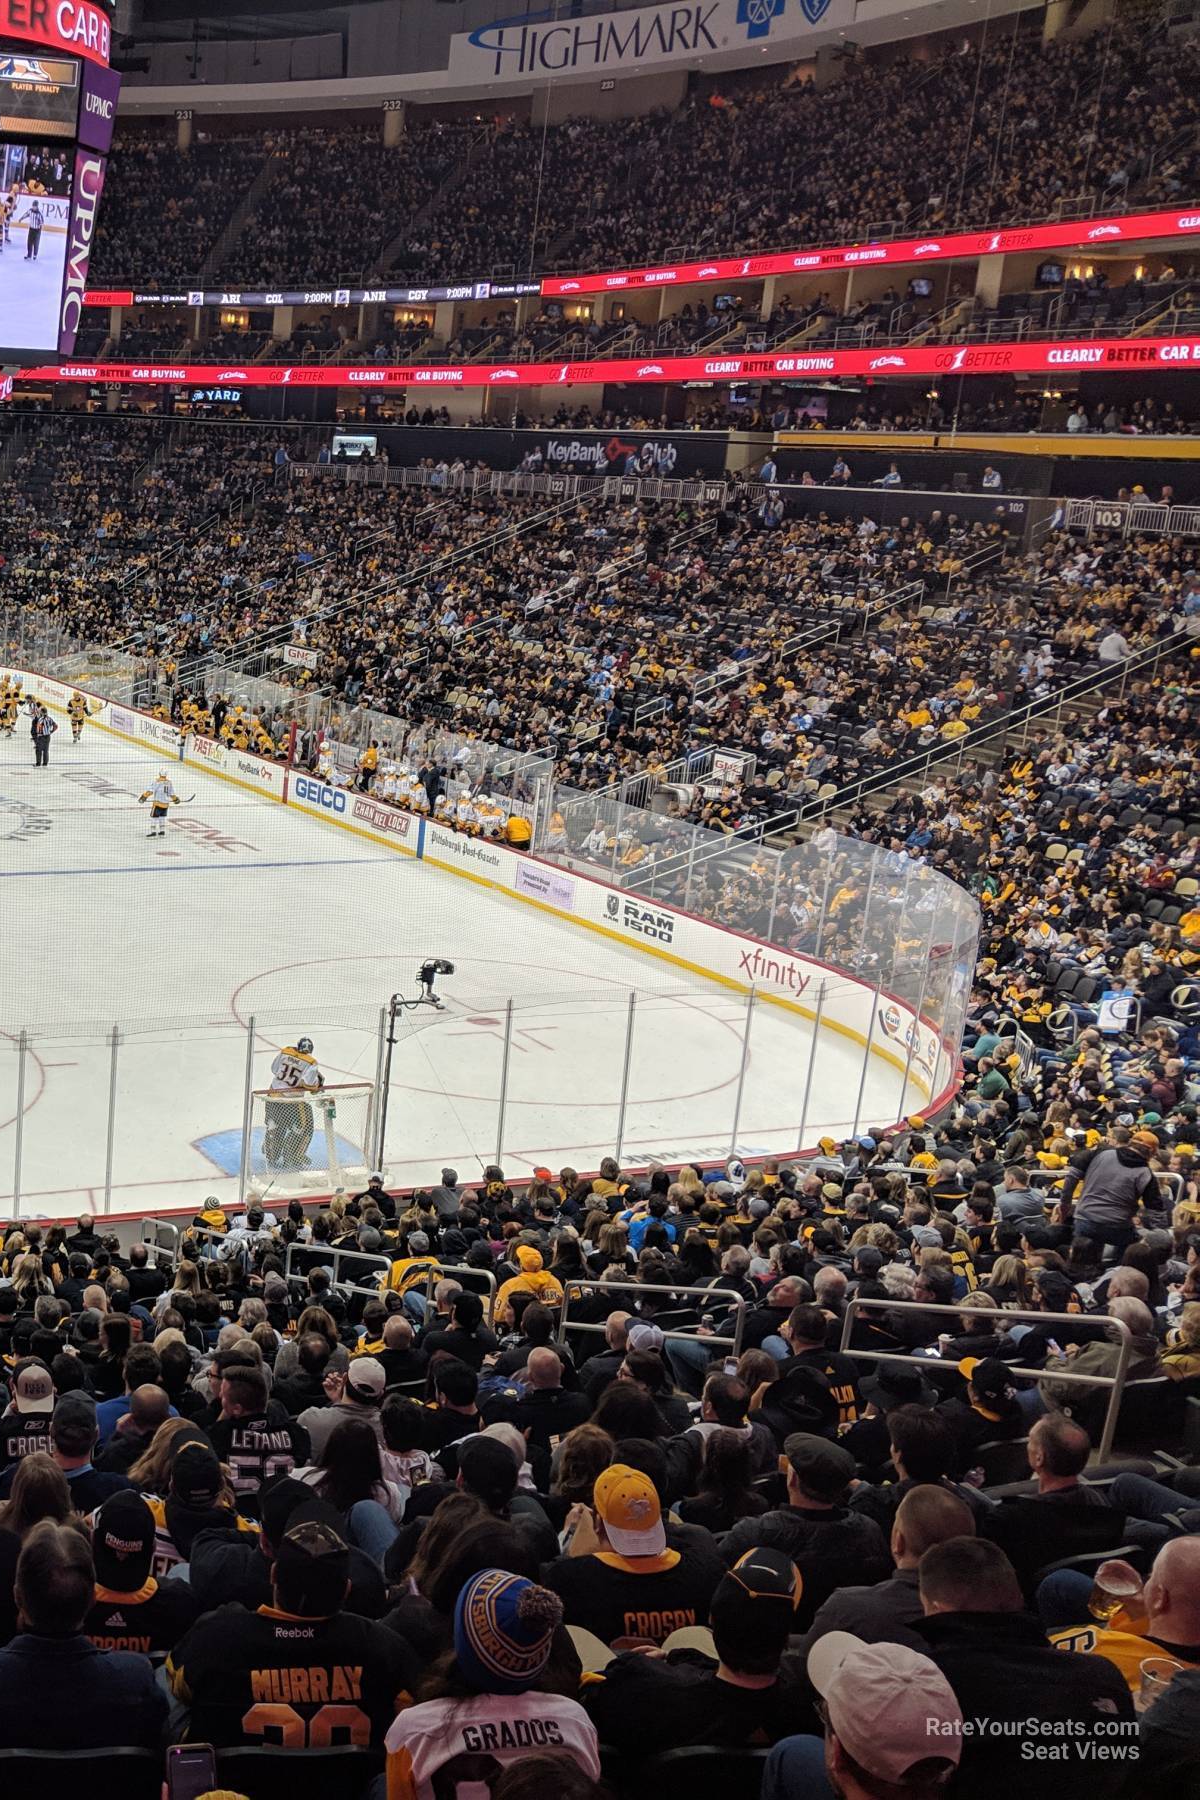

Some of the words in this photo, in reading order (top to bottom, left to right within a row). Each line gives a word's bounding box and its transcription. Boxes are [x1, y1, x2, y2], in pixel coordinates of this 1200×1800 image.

[56, 1, 100, 51] CAR
[494, 2, 720, 75] HIGHMARK
[85, 93, 113, 119] UPMC
[61, 158, 102, 334] UPMC
[1000, 234, 1033, 247] BETTER
[793, 256, 820, 266] CLEARLY
[859, 250, 886, 260] BUYING
[221, 293, 241, 304] ARI
[265, 293, 284, 304] COL
[304, 292, 332, 303] 9:00PM
[362, 291, 387, 302] ANH
[408, 289, 428, 300] CGY
[446, 287, 472, 298] 9:00PM
[966, 351, 1012, 366] BETTER
[1047, 348, 1104, 363] CLEARLY
[1160, 345, 1189, 360] CAR
[60, 367, 98, 379] CLEARLY
[132, 369, 150, 379] CAR
[151, 369, 186, 379] BUYING
[292, 371, 324, 382] BETTER
[349, 371, 386, 381] CLEARLY
[416, 371, 431, 381] CAR
[432, 370, 463, 381] BUYING
[705, 361, 741, 374] CLEARLY
[776, 359, 795, 371] CAR
[796, 358, 834, 370] BUYING
[206, 390, 241, 401] YARD
[547, 441, 605, 463] KeyBank
[551, 481, 564, 492] 122
[621, 484, 635, 495] 101
[705, 488, 720, 500] 101
[1008, 503, 1024, 513] 102
[1095, 511, 1122, 527] 103
[238, 759, 261, 777] KeyBank
[295, 776, 346, 813] GEICO
[603, 914, 619, 923] RAM
[623, 904, 674, 932] RAM
[623, 916, 673, 944] 1500
[738, 948, 811, 998] xfinity
[884, 1011, 901, 1027] Gulf
[277, 1063, 302, 1087] 35
[231, 1429, 292, 1449] LETANG
[275, 1626, 315, 1639] Reebok
[623, 1608, 697, 1639] CROSBY
[250, 1665, 364, 1703] MURRAY
[461, 1717, 565, 1752] GRADOS
